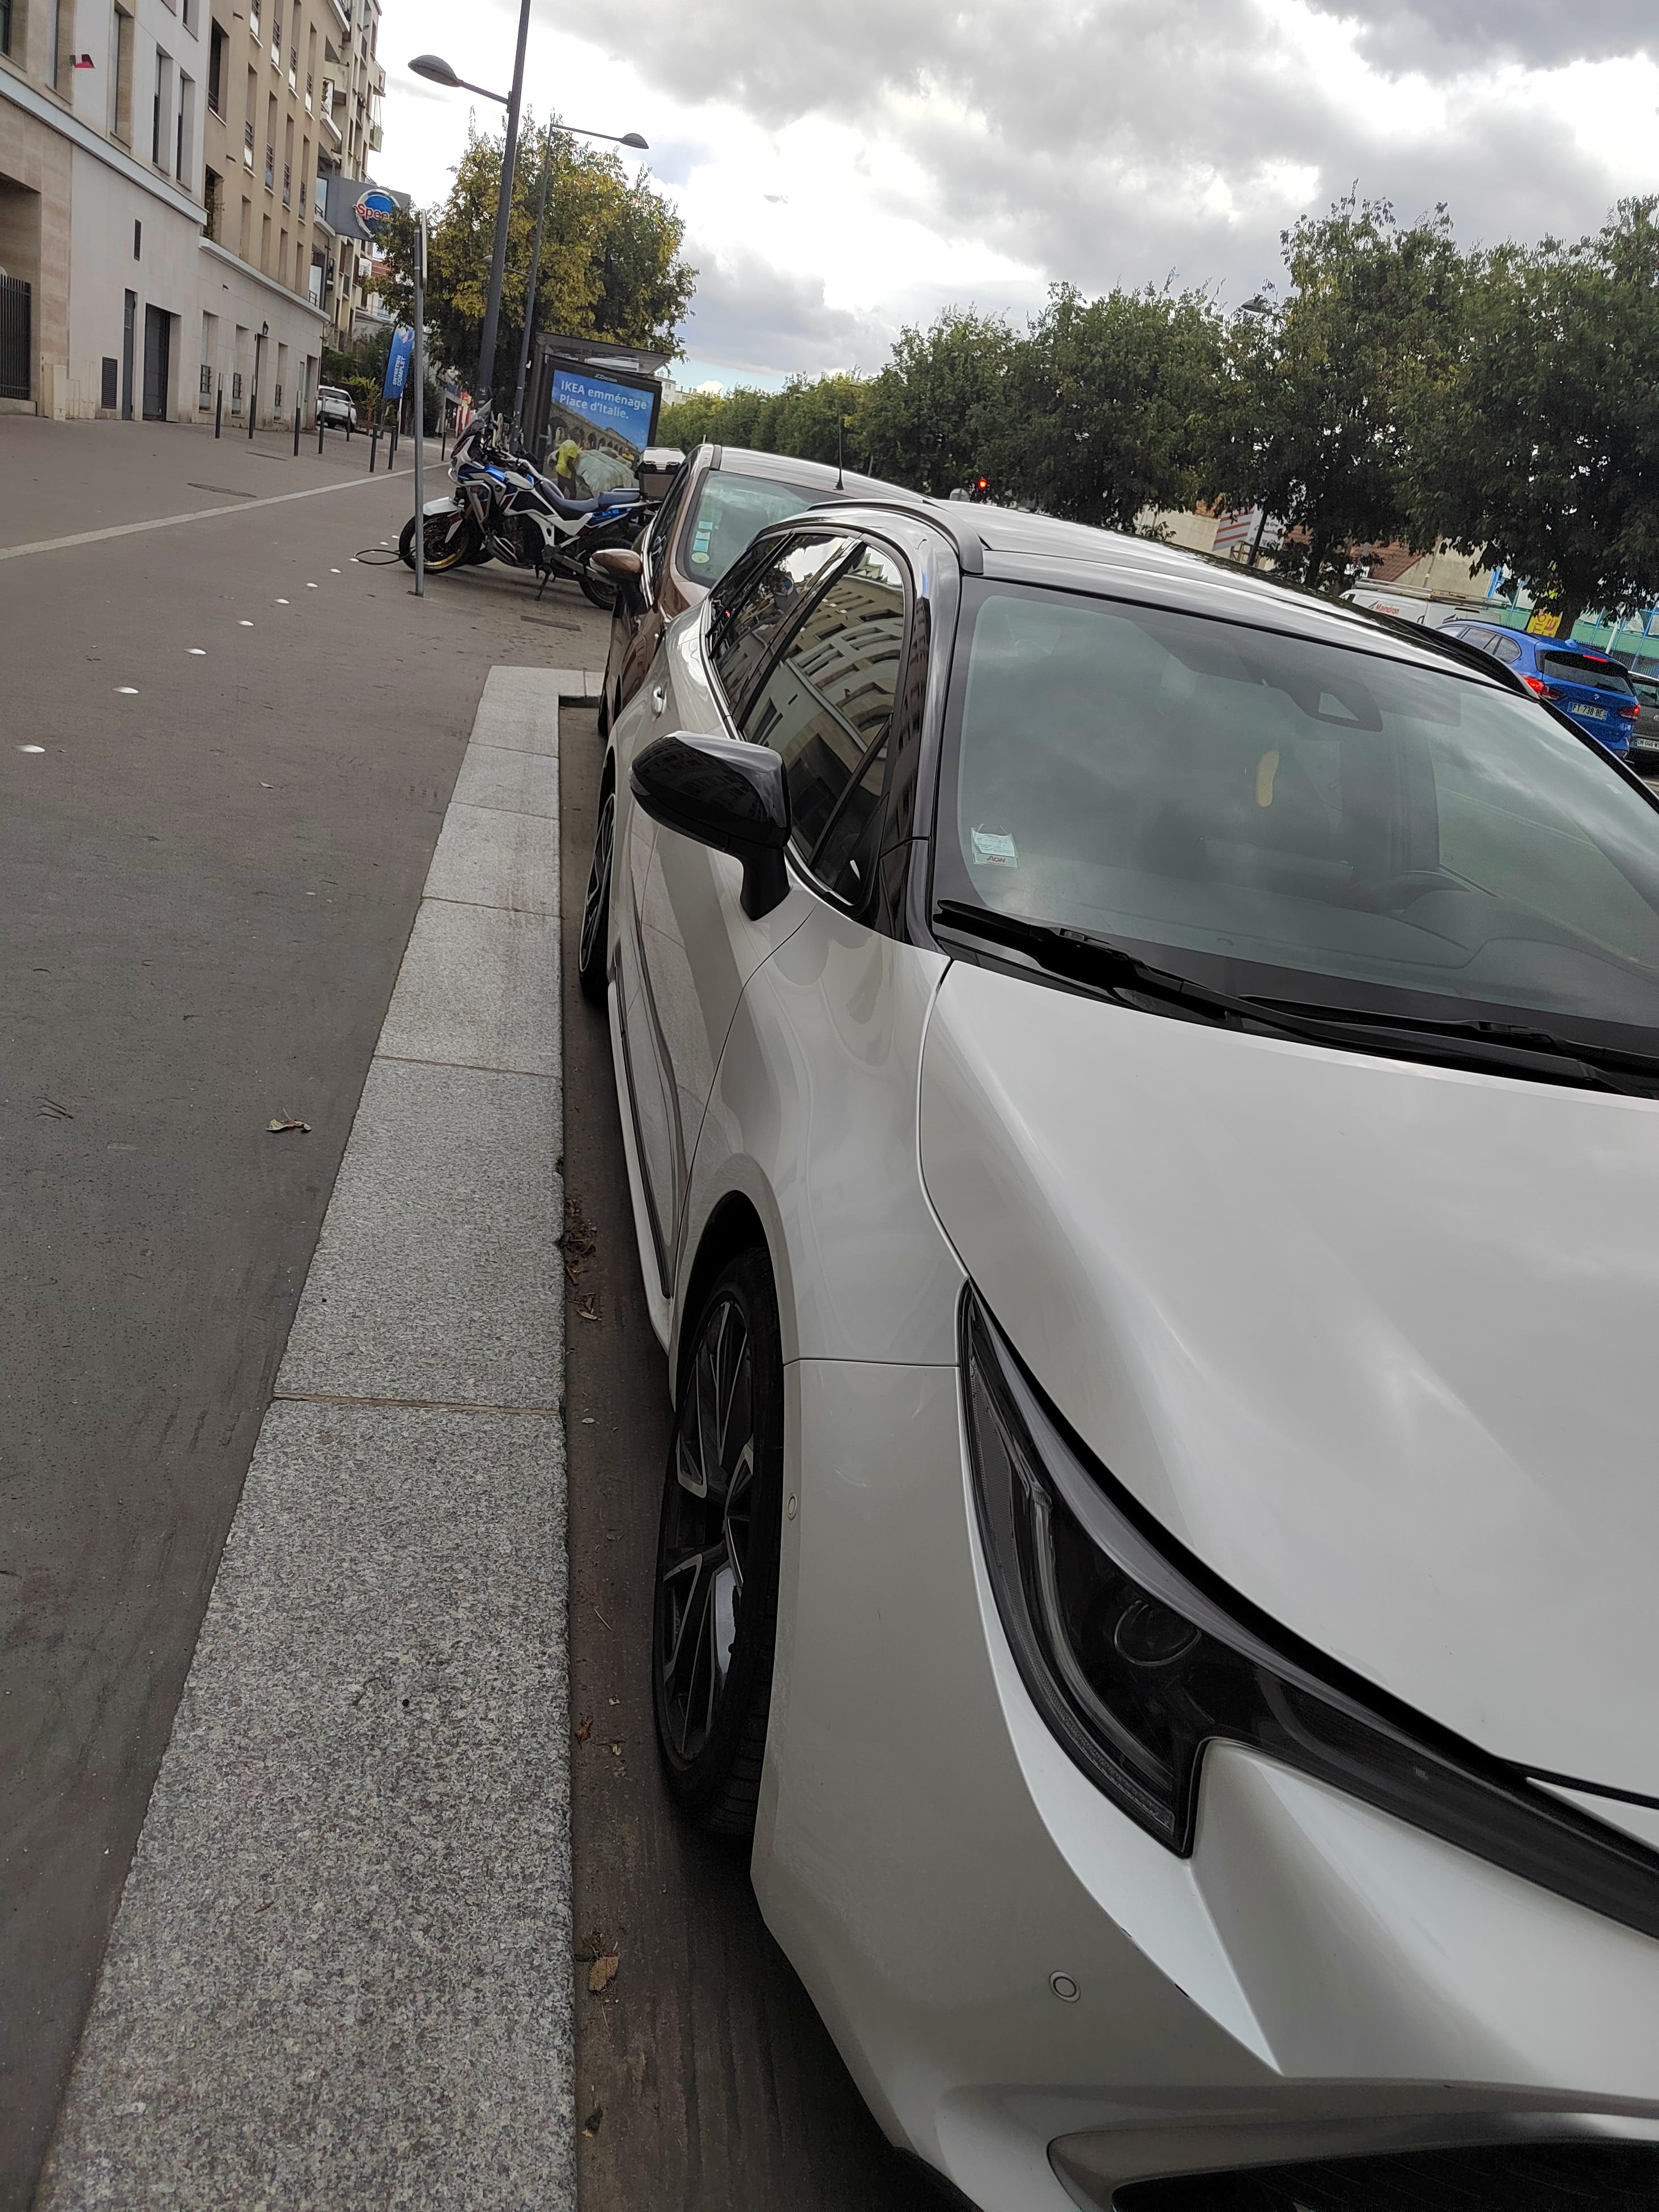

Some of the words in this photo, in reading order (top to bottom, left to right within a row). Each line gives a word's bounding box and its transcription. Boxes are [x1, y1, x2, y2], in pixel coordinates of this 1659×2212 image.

[393, 355, 402, 385] ENTRETIEN
[397, 355, 406, 386] COMPLET
[559, 394, 588, 409] Place
[561, 380, 585, 395] IKEA
[587, 389, 647, 410] emménage
